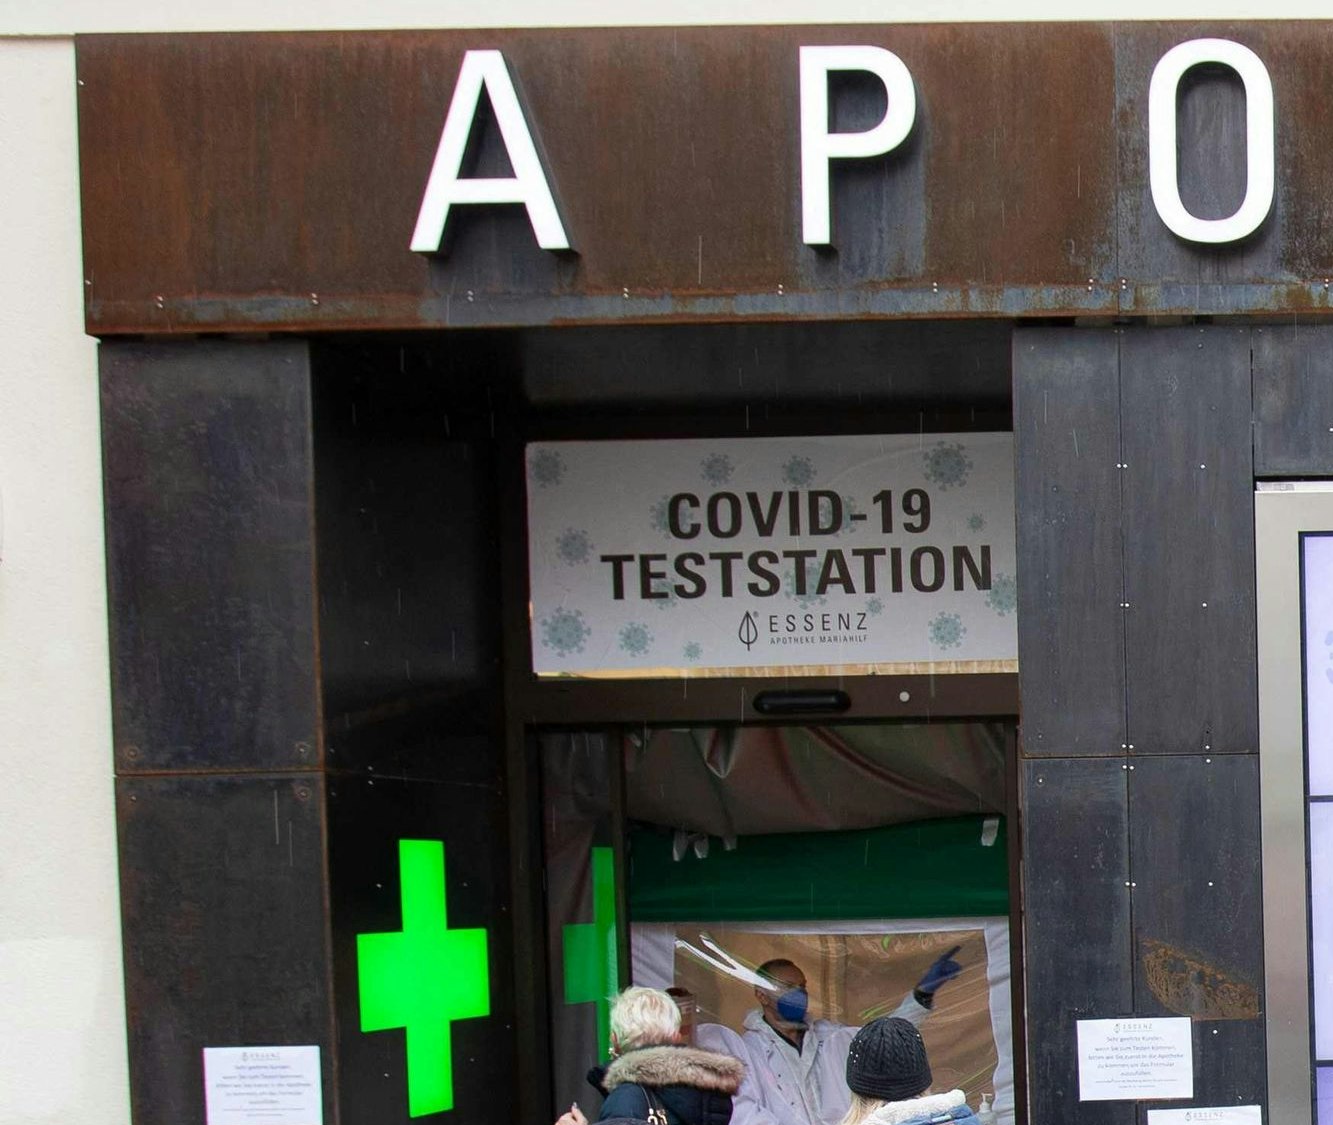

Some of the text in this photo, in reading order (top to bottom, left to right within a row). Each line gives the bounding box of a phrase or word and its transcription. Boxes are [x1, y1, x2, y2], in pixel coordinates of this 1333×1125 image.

[667, 488, 932, 541] COVID-19
[600, 544, 993, 601] TESTSTATION
[769, 612, 868, 633] ESSENZ
[770, 634, 868, 645] APOTHEKE MARIAHILF
